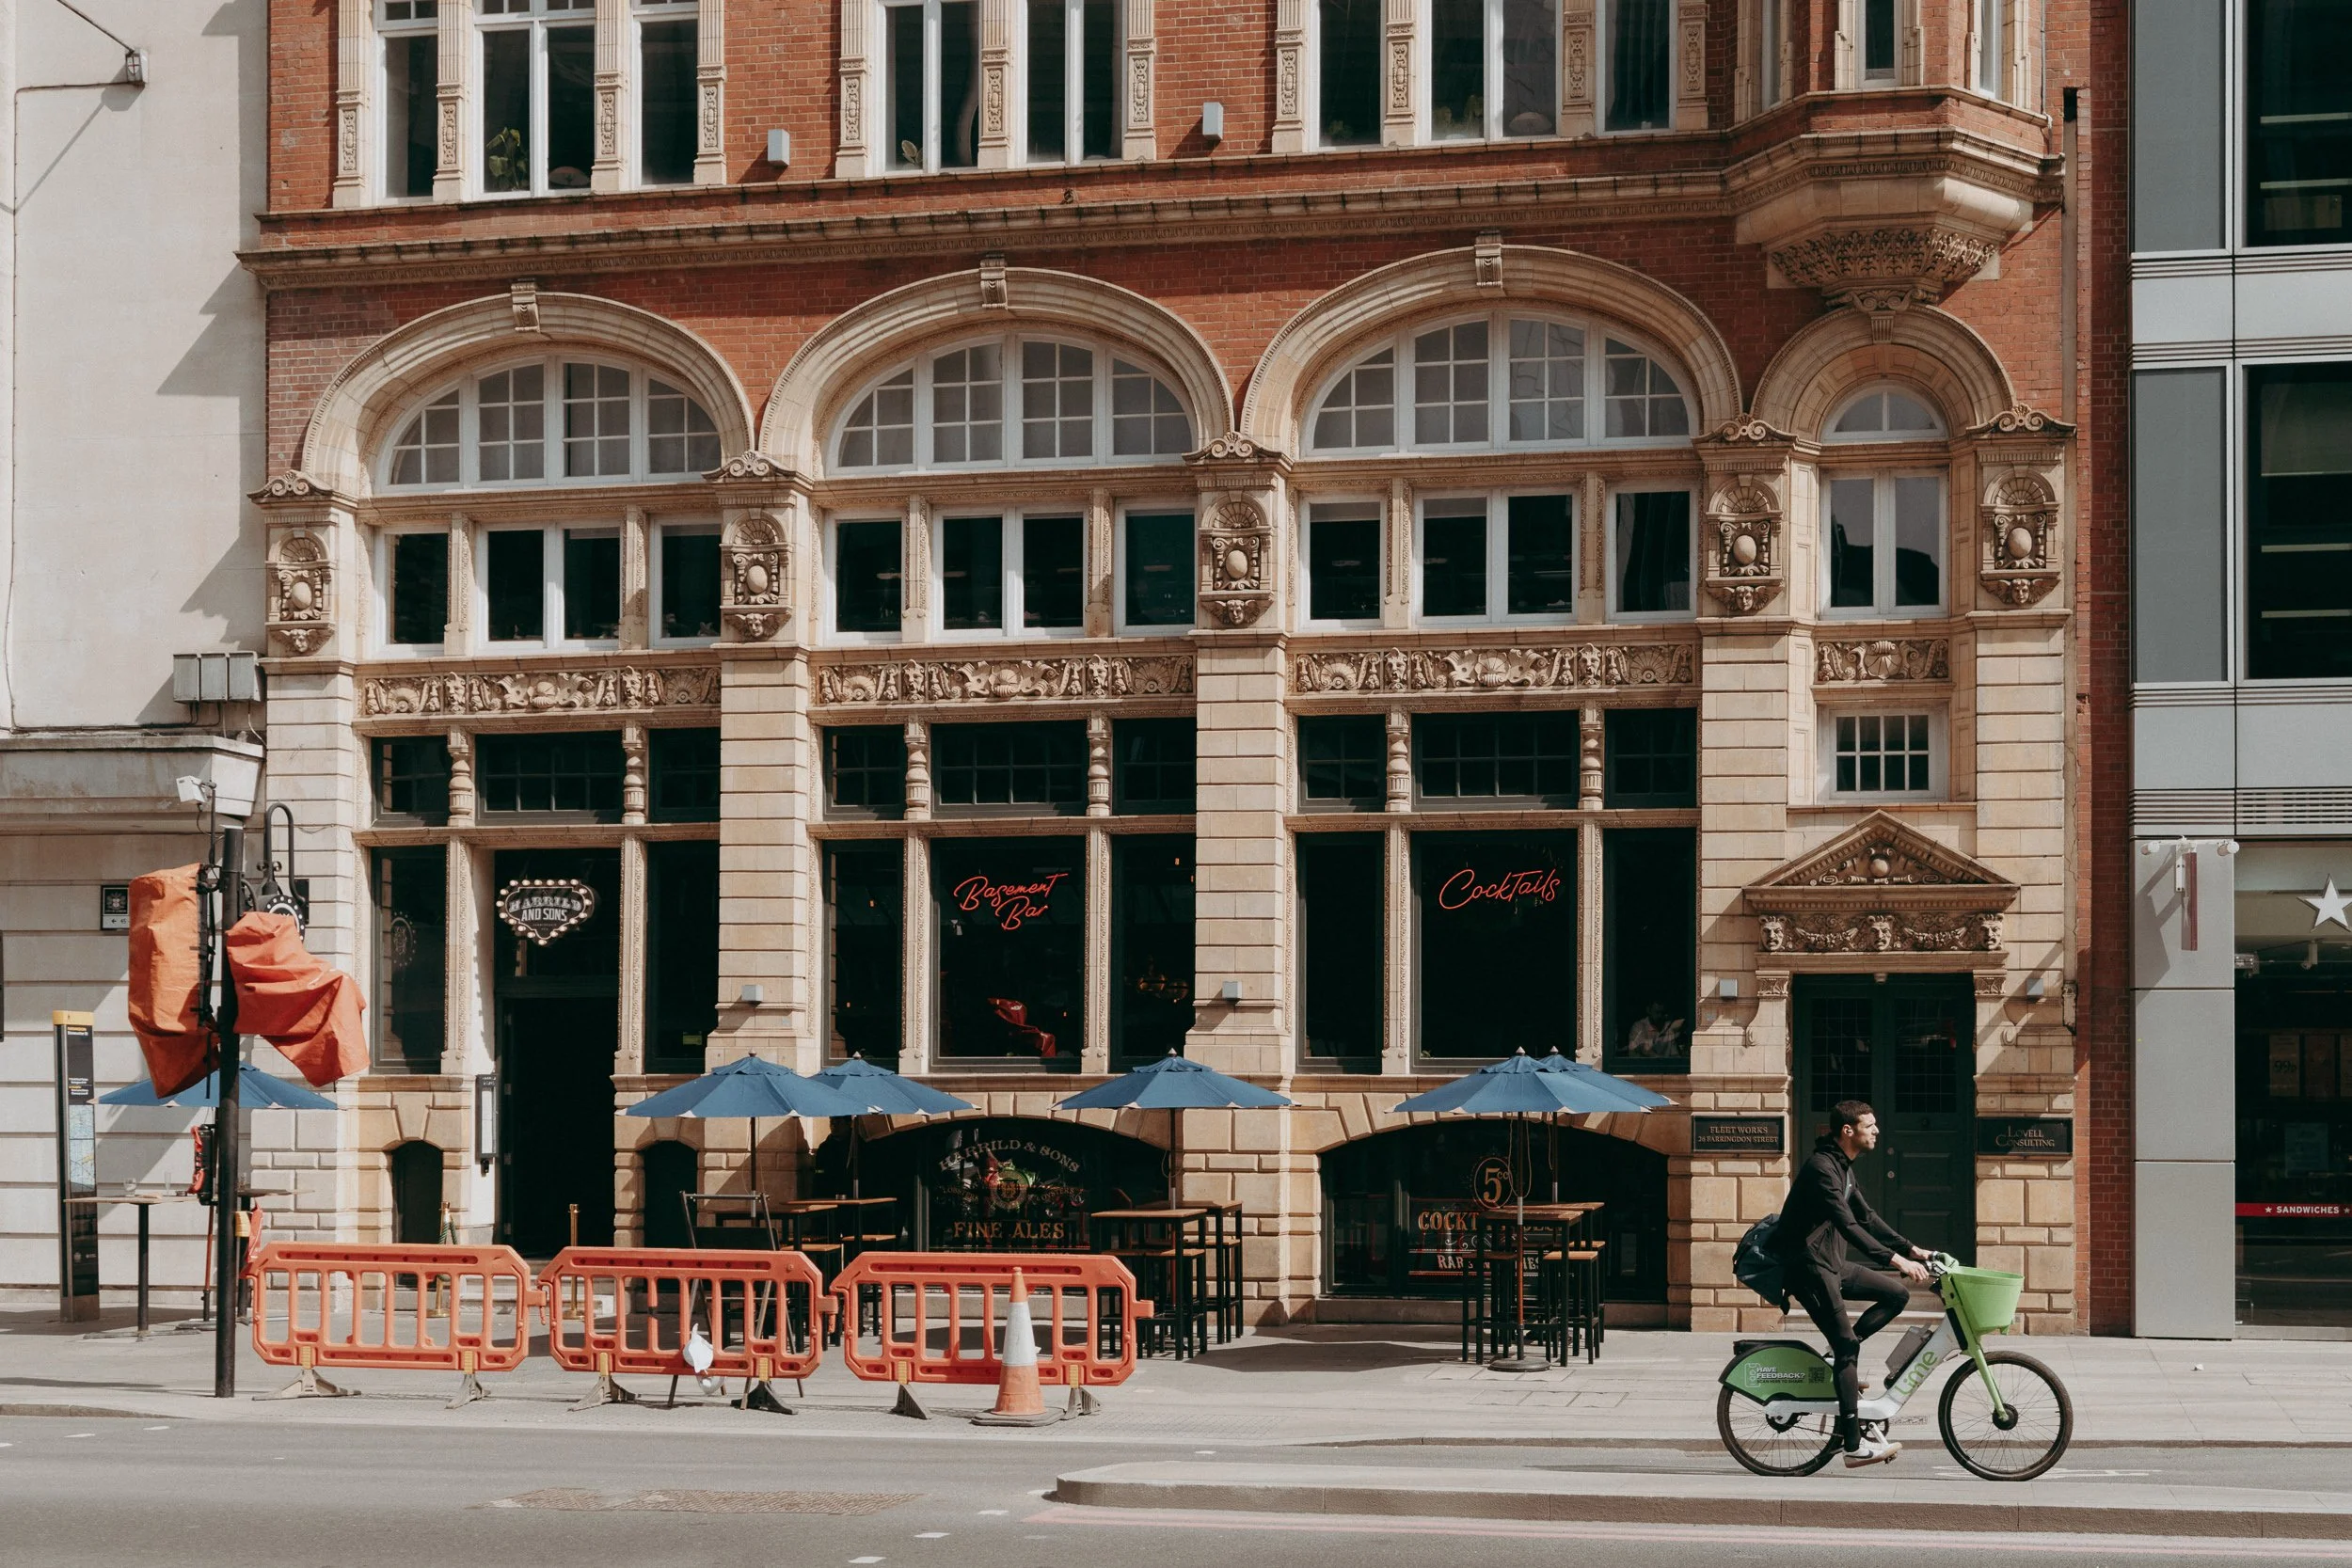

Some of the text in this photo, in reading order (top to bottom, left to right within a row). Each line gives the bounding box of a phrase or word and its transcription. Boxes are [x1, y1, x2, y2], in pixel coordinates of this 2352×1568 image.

[953, 873, 1069, 911] Basement
[1438, 868, 1561, 910] Cocktails
[509, 896, 582, 913] HARRILD
[994, 895, 1049, 930] Bar
[520, 908, 568, 922] AND SONS
[1709, 1126, 1769, 1134] FLEET WORKS
[939, 1139, 1081, 1173] HARRILD & SONS
[2276, 1205, 2340, 1214] SANDWICHES
[953, 1222, 1065, 1239] FINE ALES
